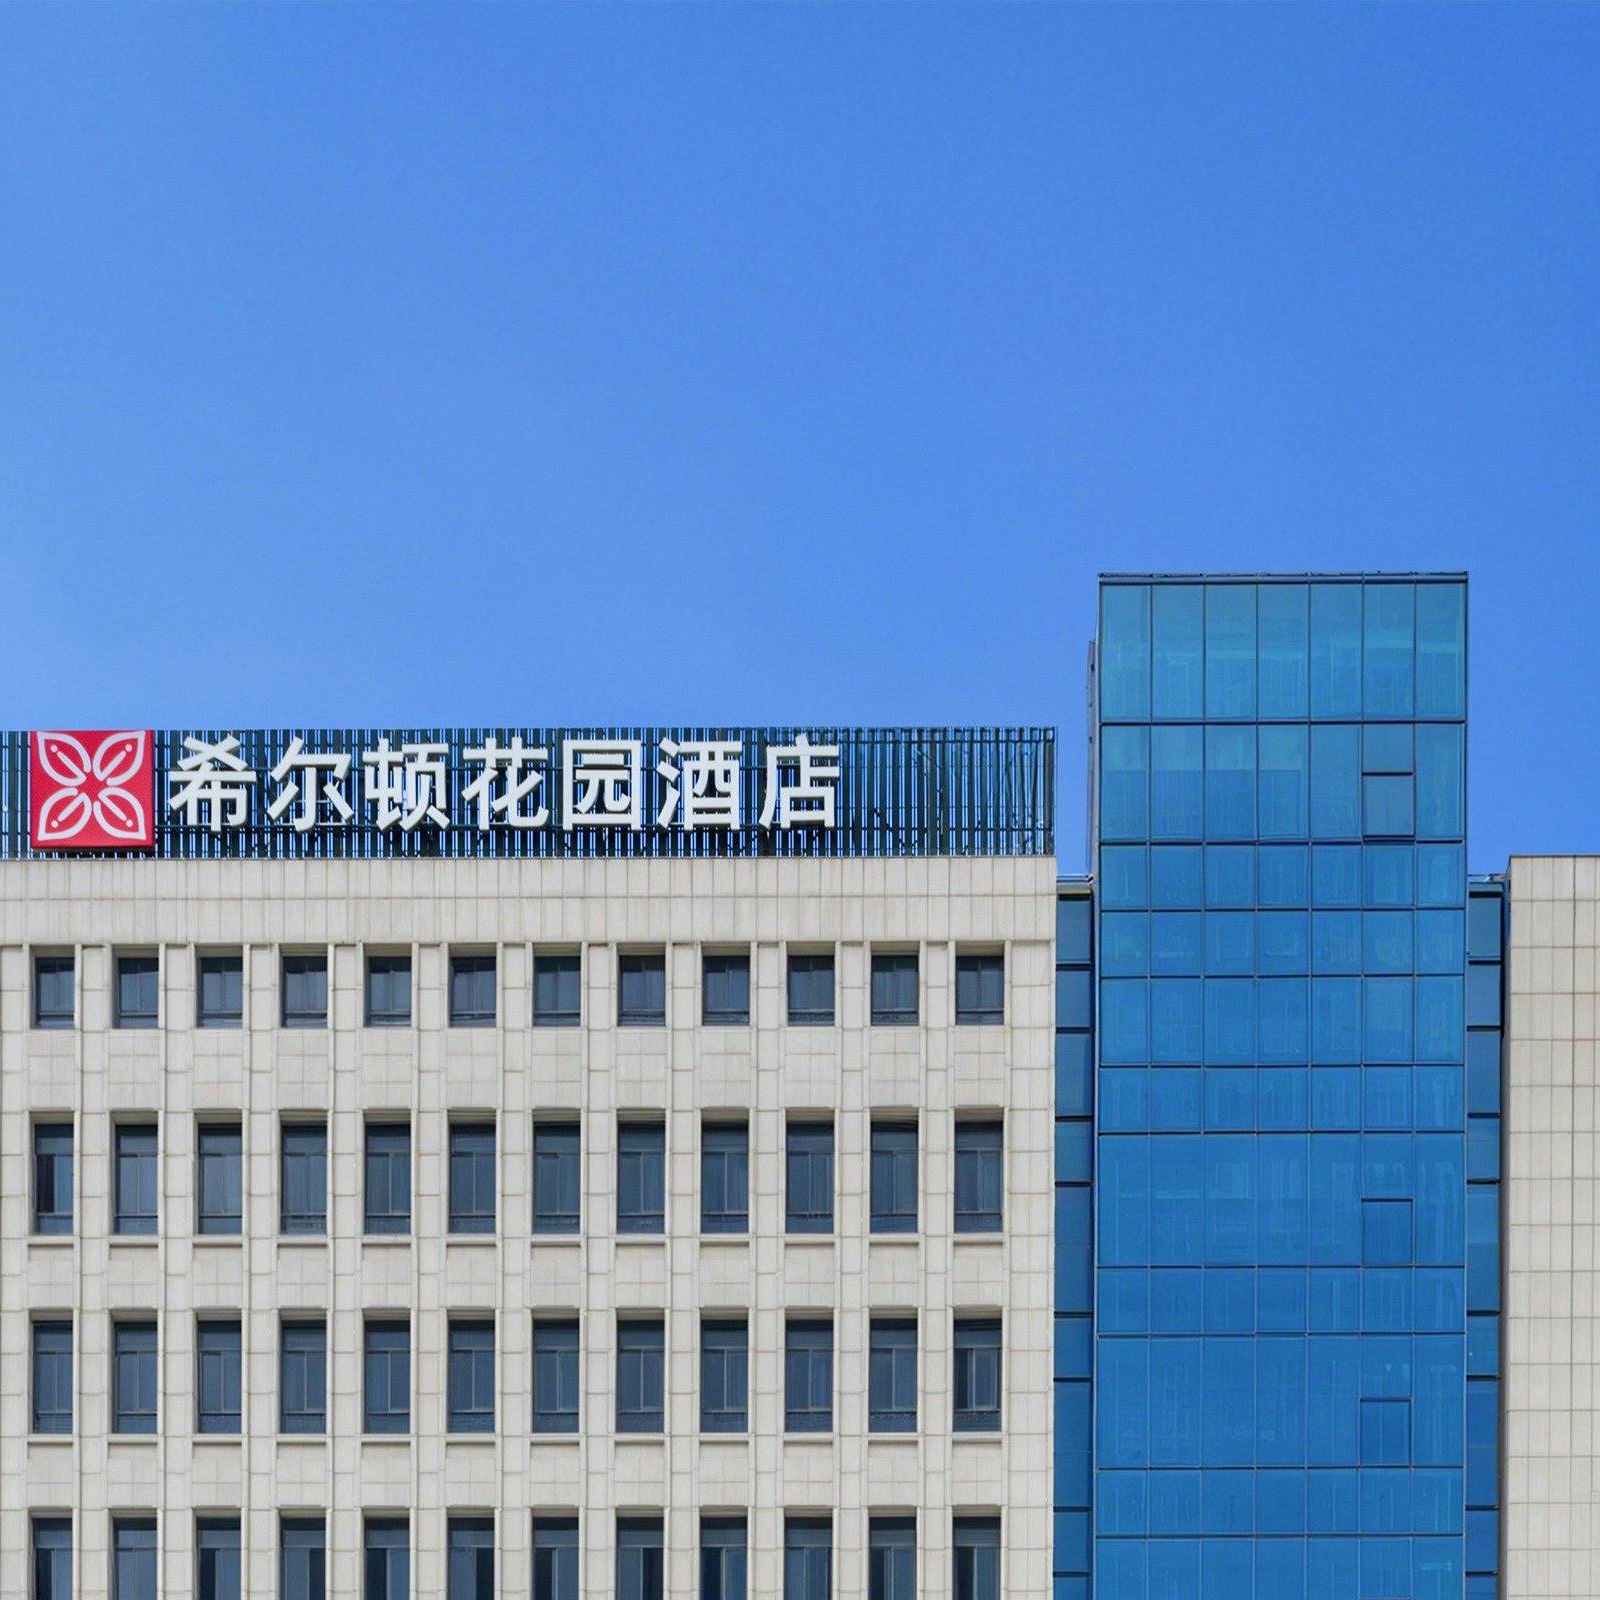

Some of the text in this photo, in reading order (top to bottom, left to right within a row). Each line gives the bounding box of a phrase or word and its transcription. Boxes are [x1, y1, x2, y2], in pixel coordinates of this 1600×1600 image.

[168, 736, 839, 835] 希尔顿花园酒店
